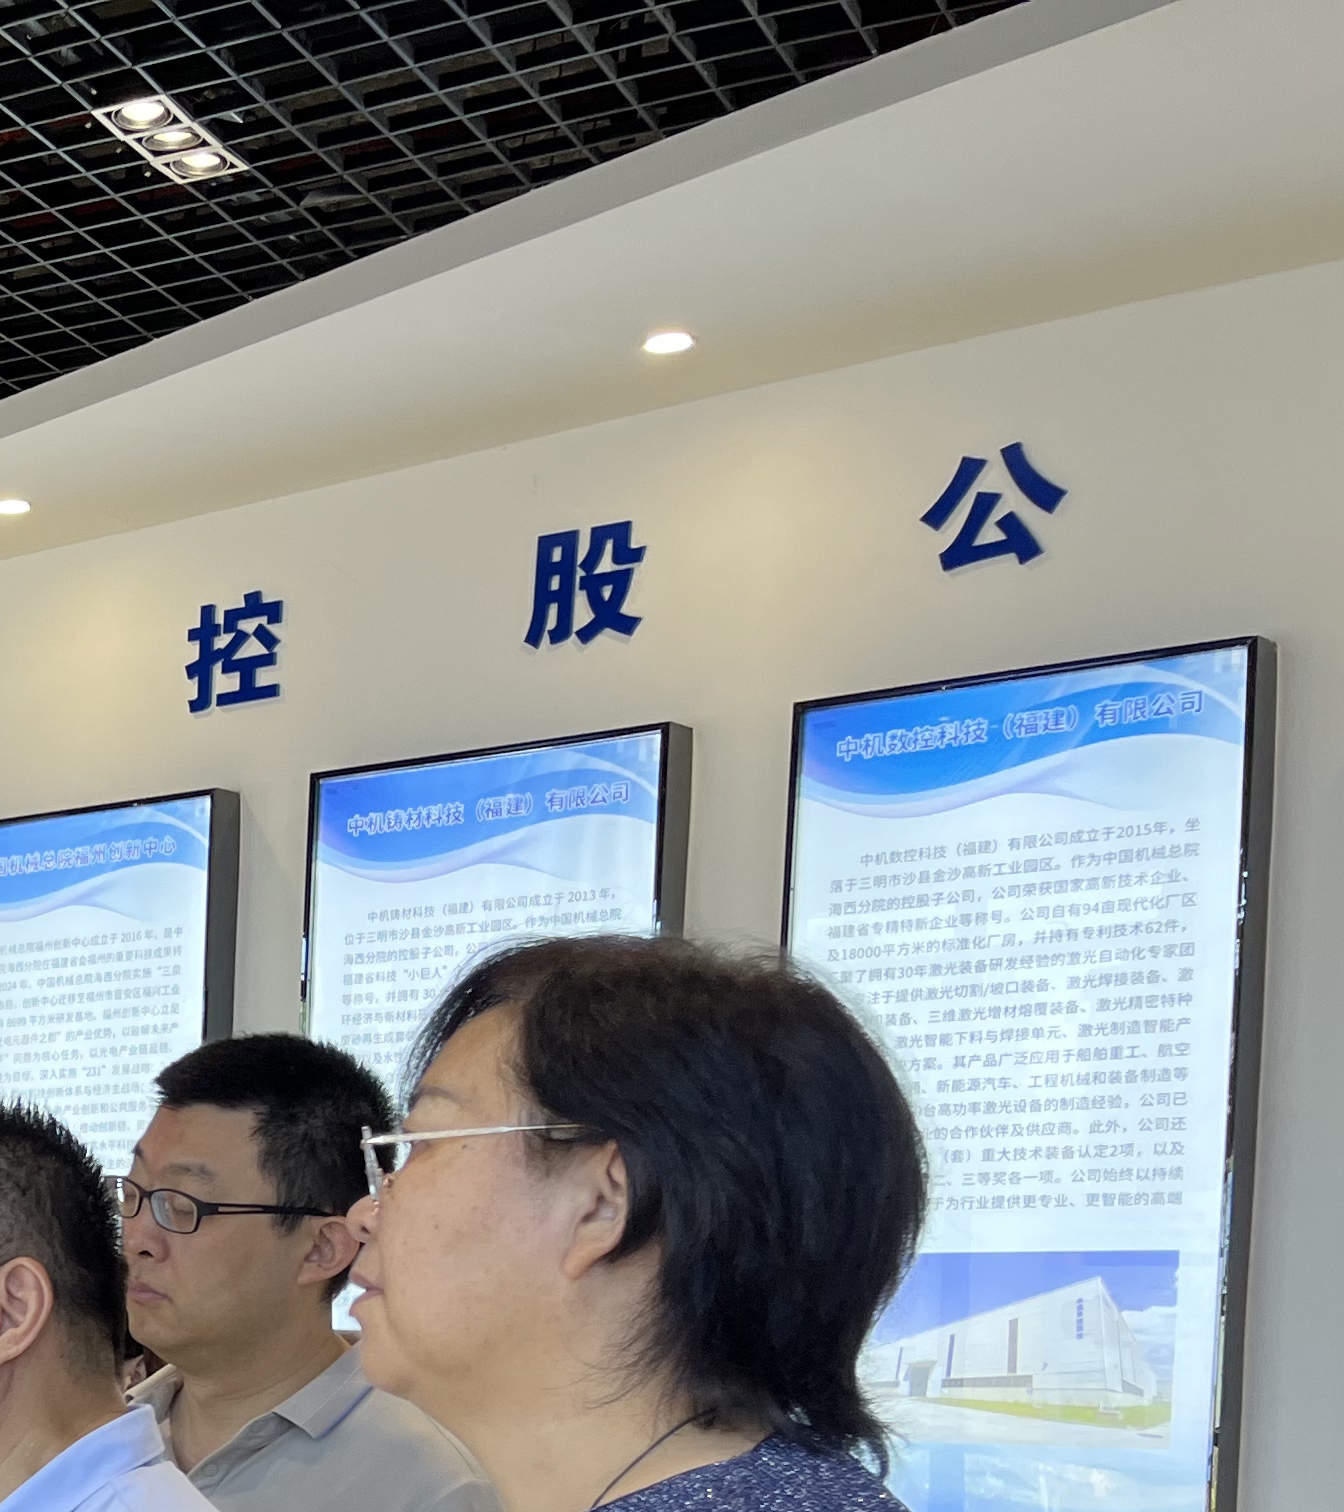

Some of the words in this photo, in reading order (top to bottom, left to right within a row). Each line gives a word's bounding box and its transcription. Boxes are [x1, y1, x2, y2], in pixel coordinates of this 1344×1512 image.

[186, 589, 284, 715] 控
[523, 520, 647, 649] 股
[919, 441, 1069, 572] 公
[836, 689, 1204, 762] 中机数控科技（福建）有限公司
